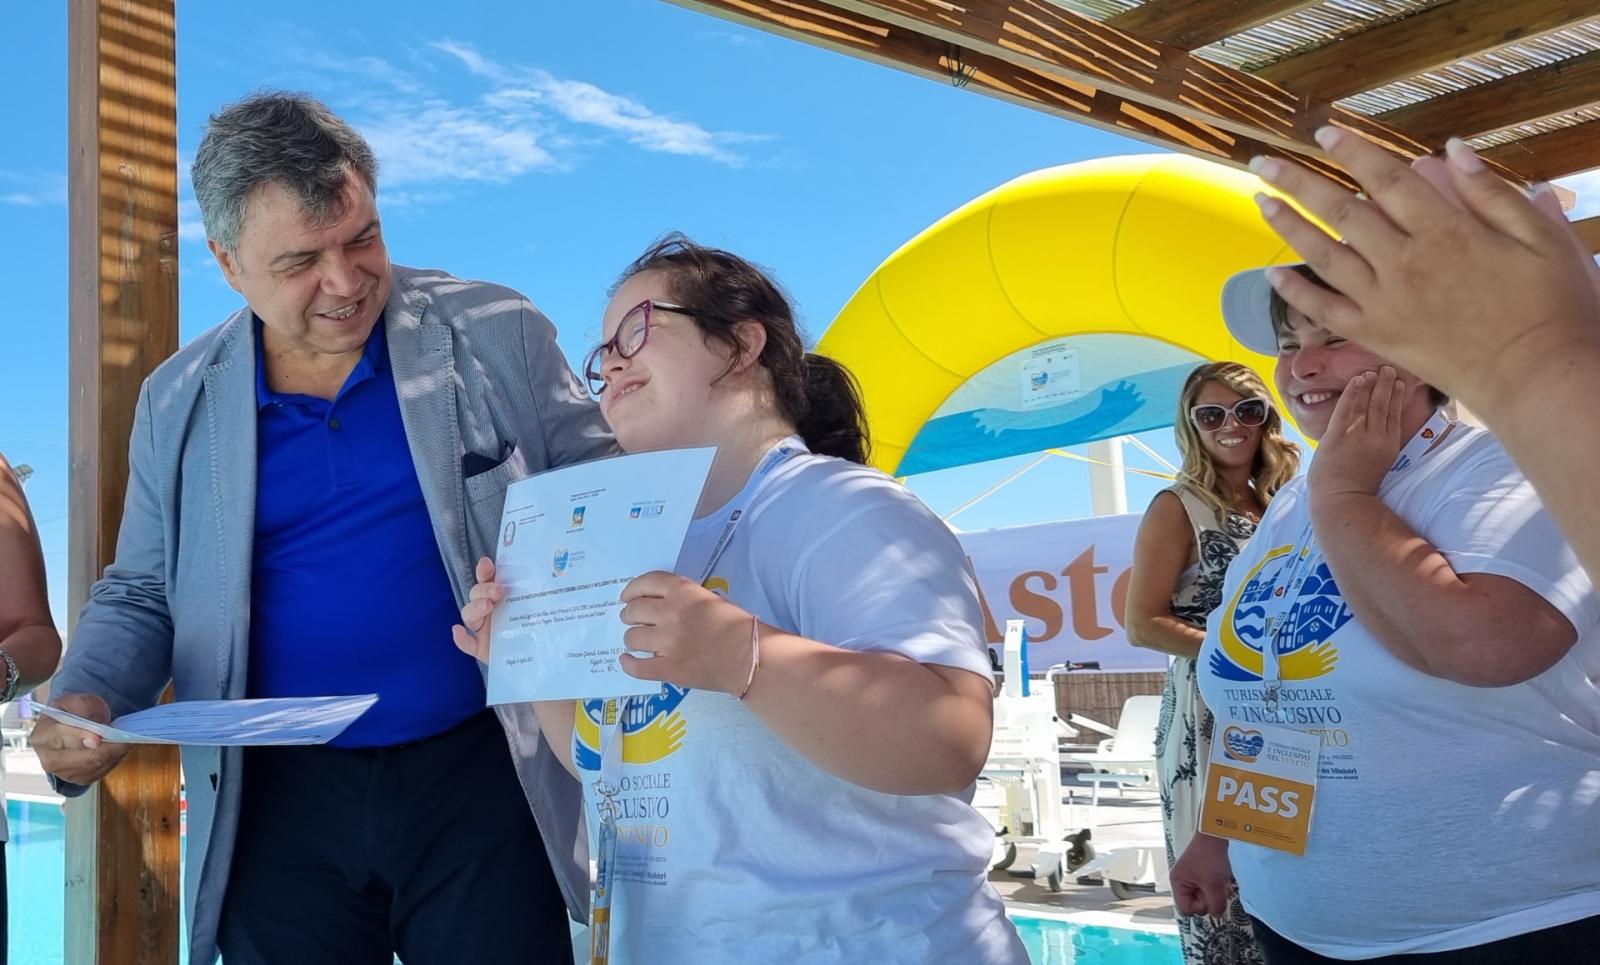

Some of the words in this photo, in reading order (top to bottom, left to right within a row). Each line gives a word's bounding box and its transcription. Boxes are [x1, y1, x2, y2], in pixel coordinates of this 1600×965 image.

[1223, 689, 1278, 701] TURISM
[1280, 689, 1336, 701] SOCIALE
[1242, 706, 1342, 724] INCLUSIVO
[633, 773, 671, 791] SOCIALE
[1217, 776, 1300, 818] PASS
